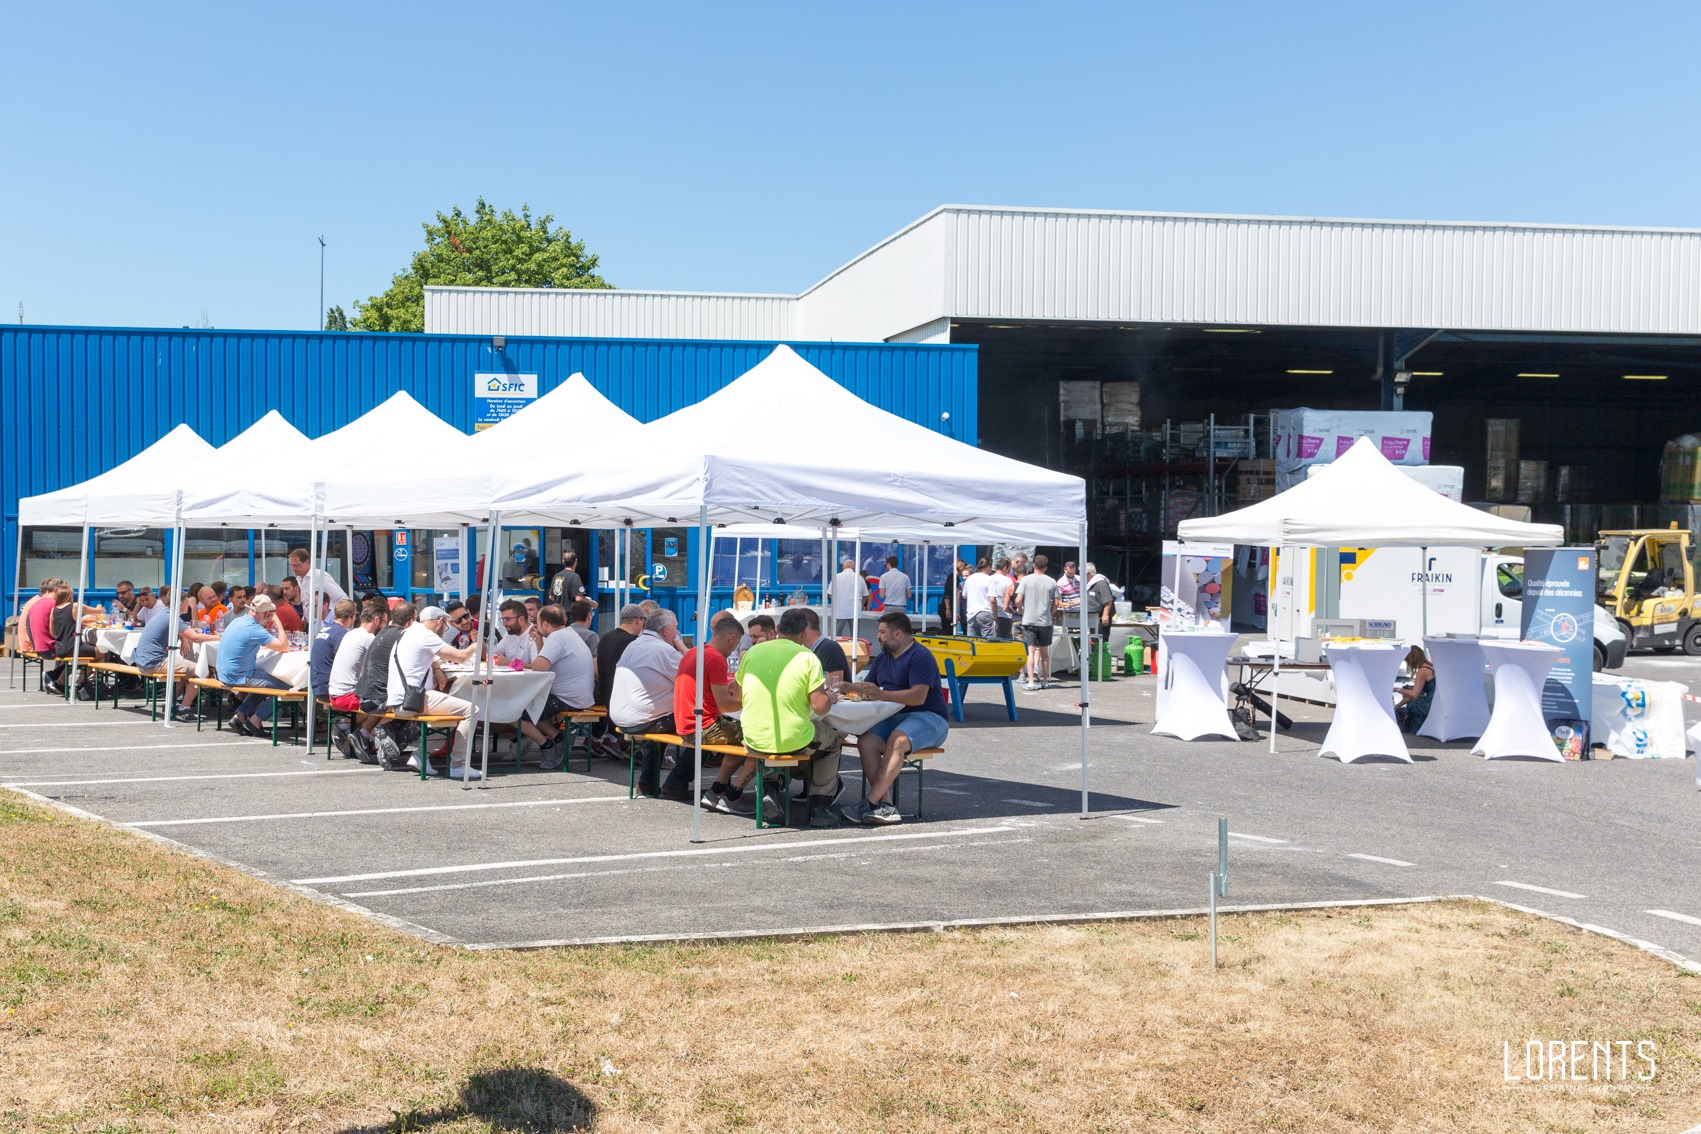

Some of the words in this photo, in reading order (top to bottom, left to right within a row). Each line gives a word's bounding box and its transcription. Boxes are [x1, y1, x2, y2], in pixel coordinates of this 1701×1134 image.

[501, 383, 525, 392] SFIC
[655, 565, 664, 576] P
[1411, 572, 1452, 583] FRAIKIN
[1527, 588, 1543, 597] depuis
[1544, 588, 1555, 597] des
[1555, 588, 1583, 598] décennies
